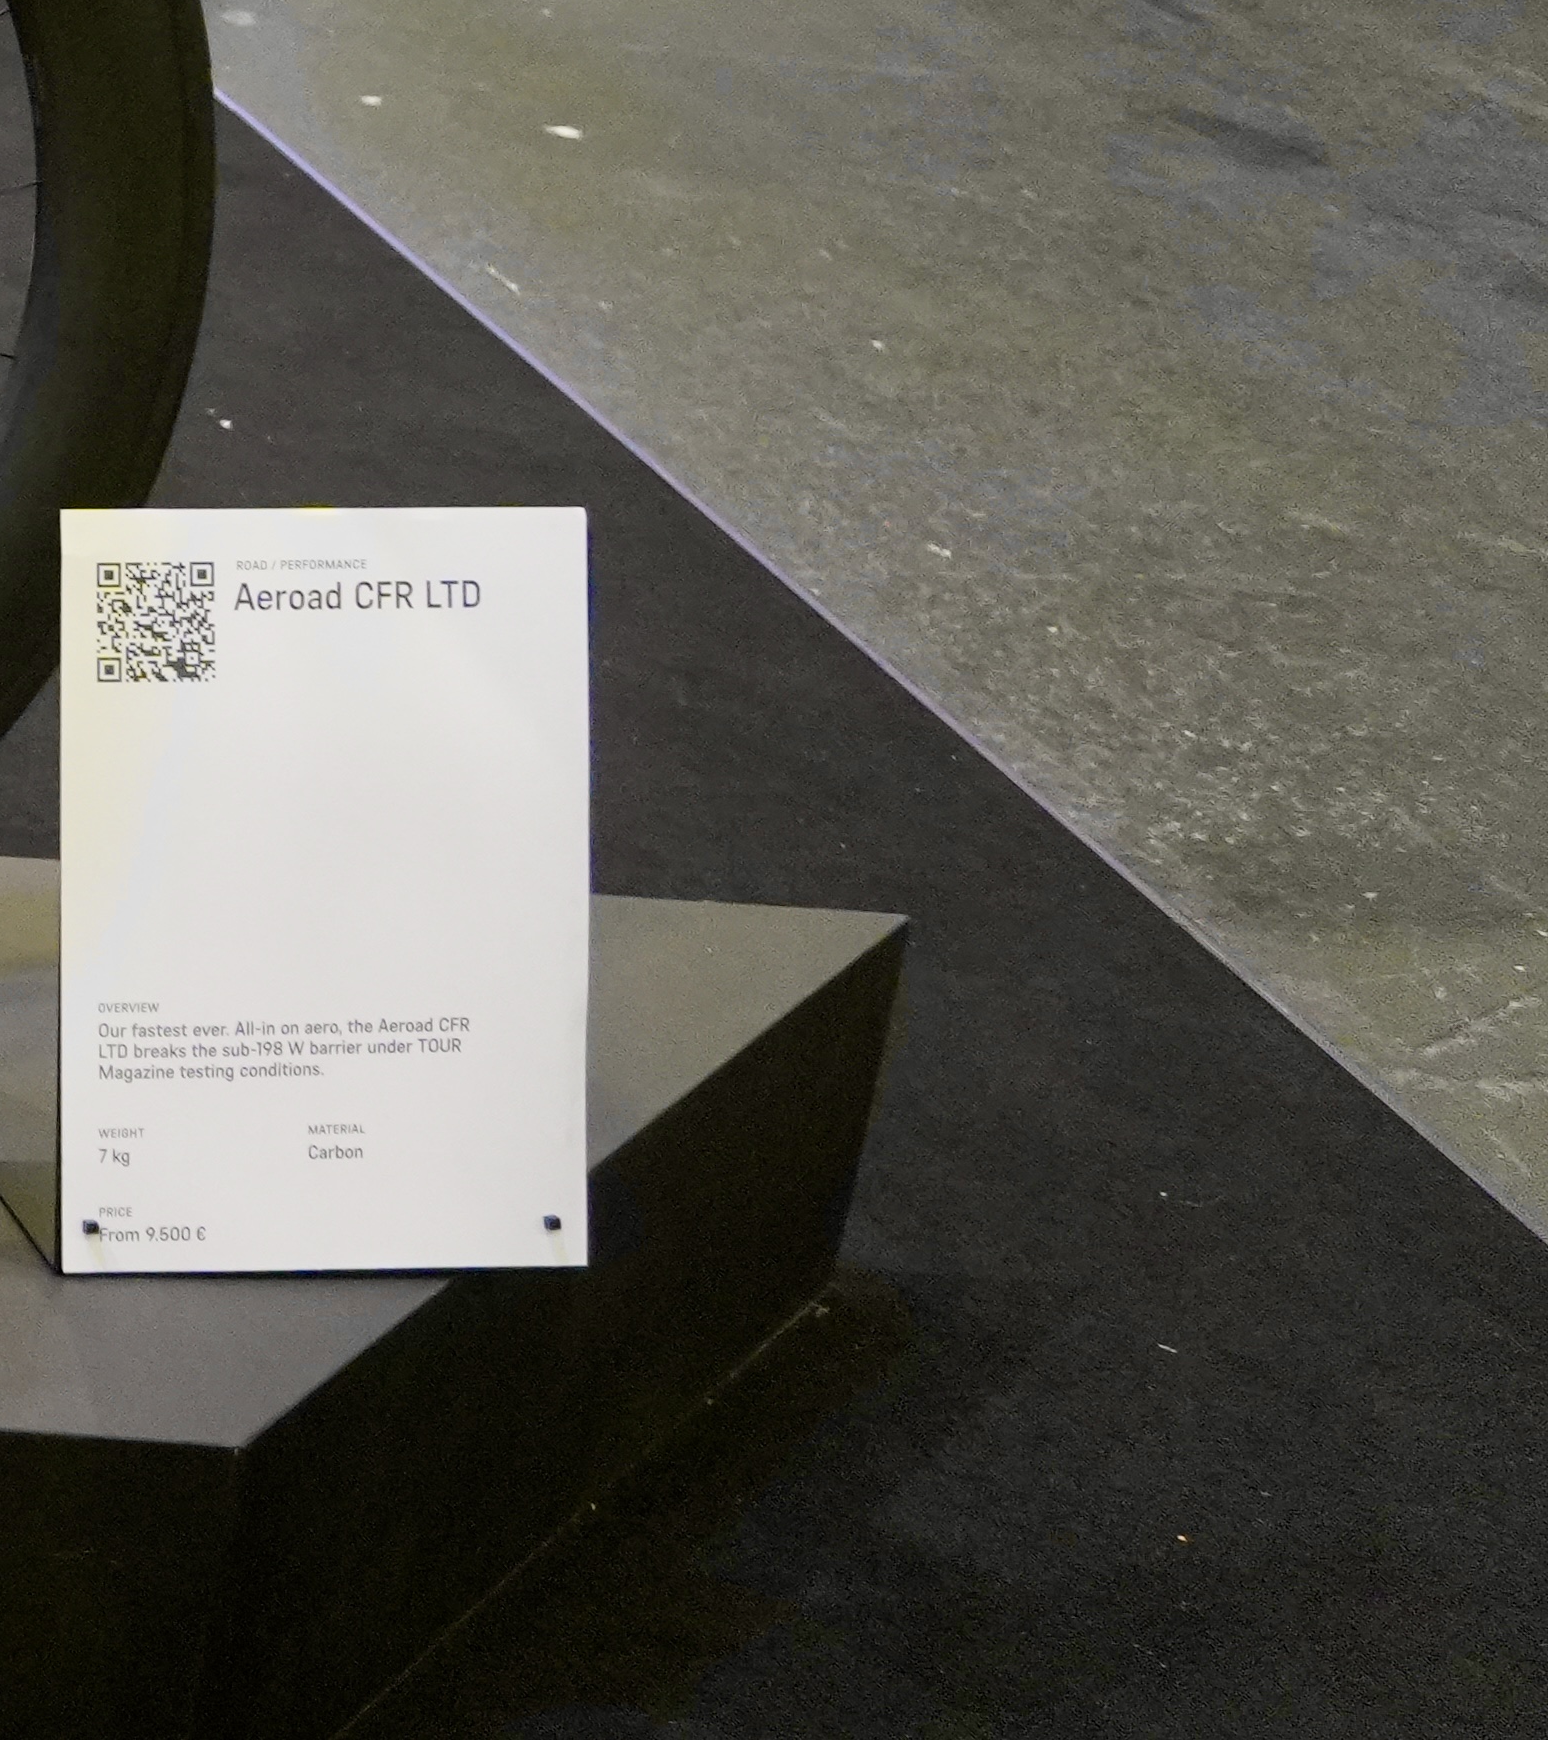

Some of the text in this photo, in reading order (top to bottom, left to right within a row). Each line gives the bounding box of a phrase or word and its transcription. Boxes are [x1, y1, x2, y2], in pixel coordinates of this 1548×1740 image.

[237, 560, 267, 570] ROAD
[281, 559, 366, 570] PERFORMANCE
[234, 580, 481, 611] Aeroad CFR LTD
[98, 1003, 159, 1013] OVERVIEW
[99, 1017, 469, 1038] Our fastest ever. All-in on aero, the Aeroad CFR
[99, 1038, 461, 1058] LTD breaks the sub-198 W barrier under TOUR
[99, 1062, 324, 1083] Magazine testing conditions.
[99, 1128, 144, 1138] WEIGHT
[308, 1124, 365, 1134] MATERIAL
[99, 1149, 130, 1167] 7 kg
[308, 1145, 363, 1159] Carbon
[99, 1207, 132, 1217] PRICE
[99, 1226, 206, 1243] From 9.500 €
